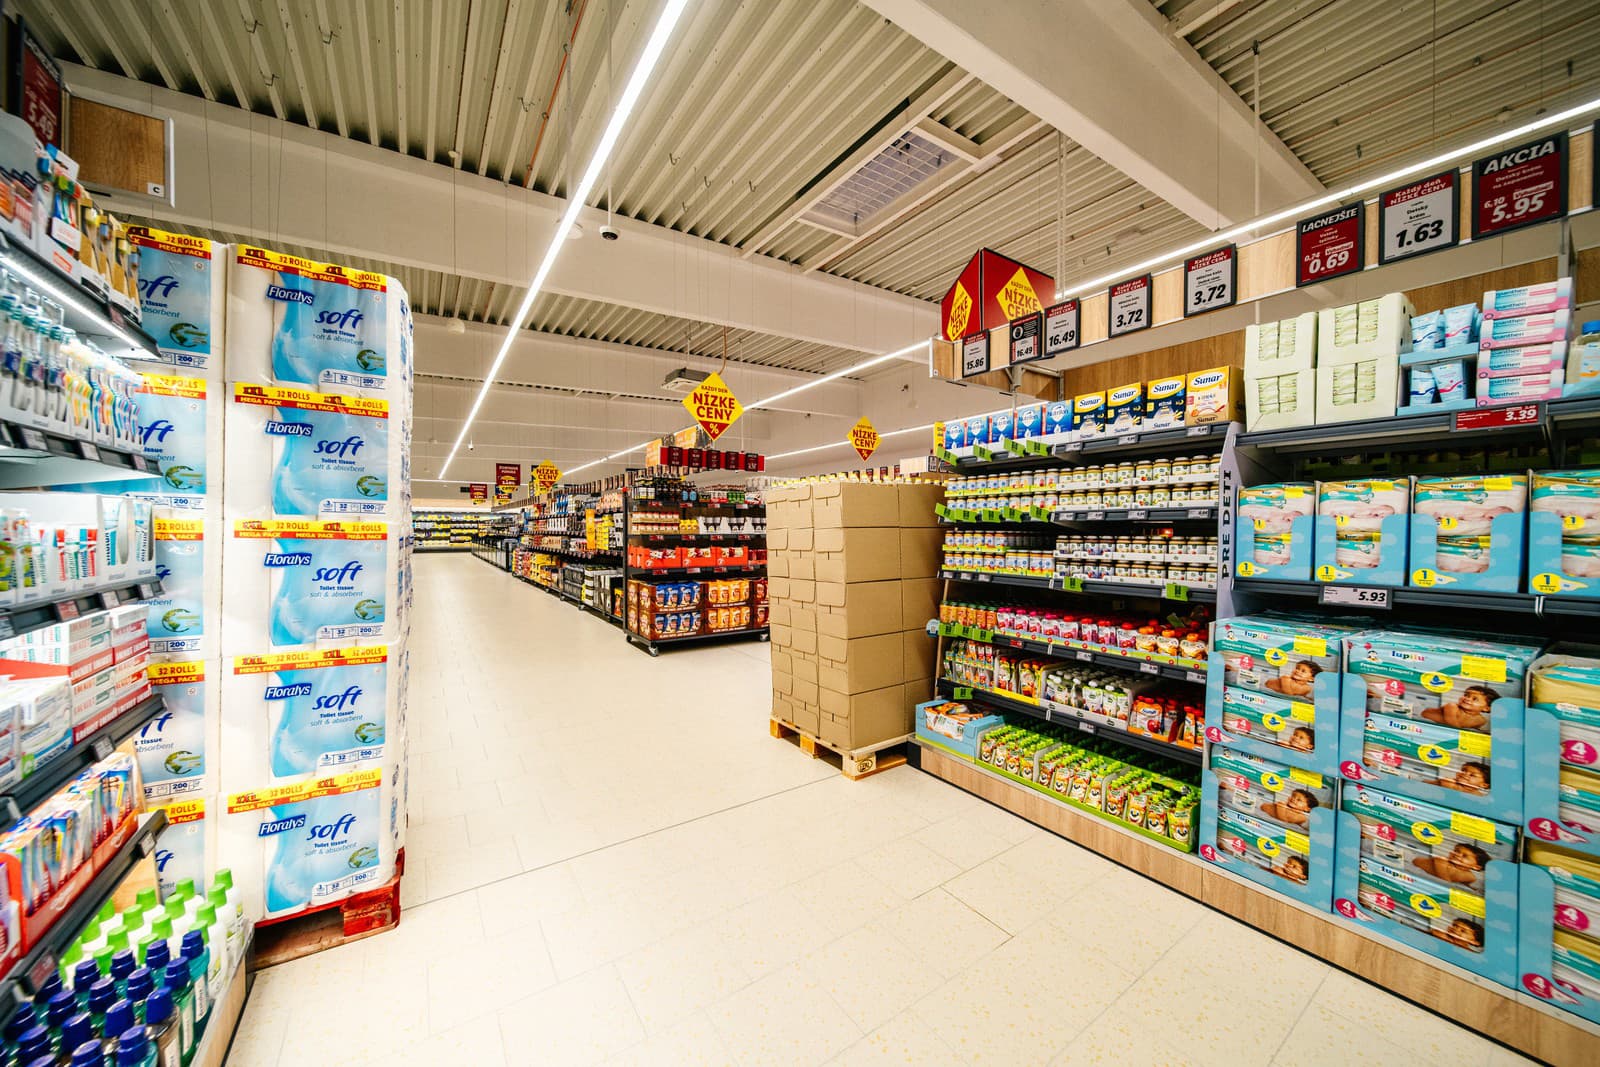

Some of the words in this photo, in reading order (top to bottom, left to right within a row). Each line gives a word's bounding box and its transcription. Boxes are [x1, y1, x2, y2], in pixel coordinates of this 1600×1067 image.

[1484, 141, 1554, 174] AKCIA
[1491, 192, 1546, 223] 5.95
[1302, 207, 1358, 233] LACNEJŠIE
[1396, 220, 1444, 248] 1.63
[177, 238, 204, 248] ROLLS
[185, 247, 204, 257] PACK
[266, 262, 284, 271] PACK
[279, 256, 288, 264] 32
[289, 258, 312, 269] ROLLS
[1309, 251, 1349, 274] 0.69
[268, 286, 314, 306] Floralys
[1005, 288, 1038, 311] NÍZKE
[1194, 284, 1226, 306] 3.72
[315, 308, 363, 329] soft
[1116, 309, 1143, 328] 3.72
[1049, 330, 1075, 347] 16.49
[1193, 374, 1222, 386] Sunar
[1153, 382, 1180, 393] Sunar
[287, 391, 311, 401] ROLLS
[363, 400, 383, 410] ROLLS
[693, 391, 735, 409] NÍZKE
[1112, 390, 1136, 400] Sunar
[263, 398, 283, 407] PACK
[1079, 398, 1101, 407] Sunar
[696, 406, 732, 421] CENY
[1504, 409, 1537, 421] 3.39
[267, 421, 312, 436] Floralys
[852, 429, 877, 440] NÍZKE
[313, 435, 364, 458] soft
[855, 439, 876, 448] CENY
[1223, 470, 1231, 526] DETI
[157, 522, 167, 530] 32
[169, 522, 195, 530] ROLLS
[286, 522, 310, 530] ROLLS
[266, 553, 311, 566] Floralys
[1221, 534, 1230, 579] PRE
[312, 560, 363, 585] soft
[1358, 591, 1386, 602] 5.93
[158, 667, 168, 675] 32
[170, 664, 196, 674] ROLLS
[177, 675, 197, 683] PACK
[266, 684, 311, 699] Floralys
[312, 685, 363, 711] soft
[1570, 742, 1586, 755] 4
[1347, 763, 1356, 773] 4
[173, 782, 188, 790] 200
[171, 804, 197, 815] ROLLS
[260, 815, 306, 836] Floralys
[306, 813, 357, 841] soft
[1538, 820, 1552, 833] 4
[1342, 902, 1352, 912] 4
[1563, 908, 1578, 922] 4
[1532, 976, 1546, 989] 4
